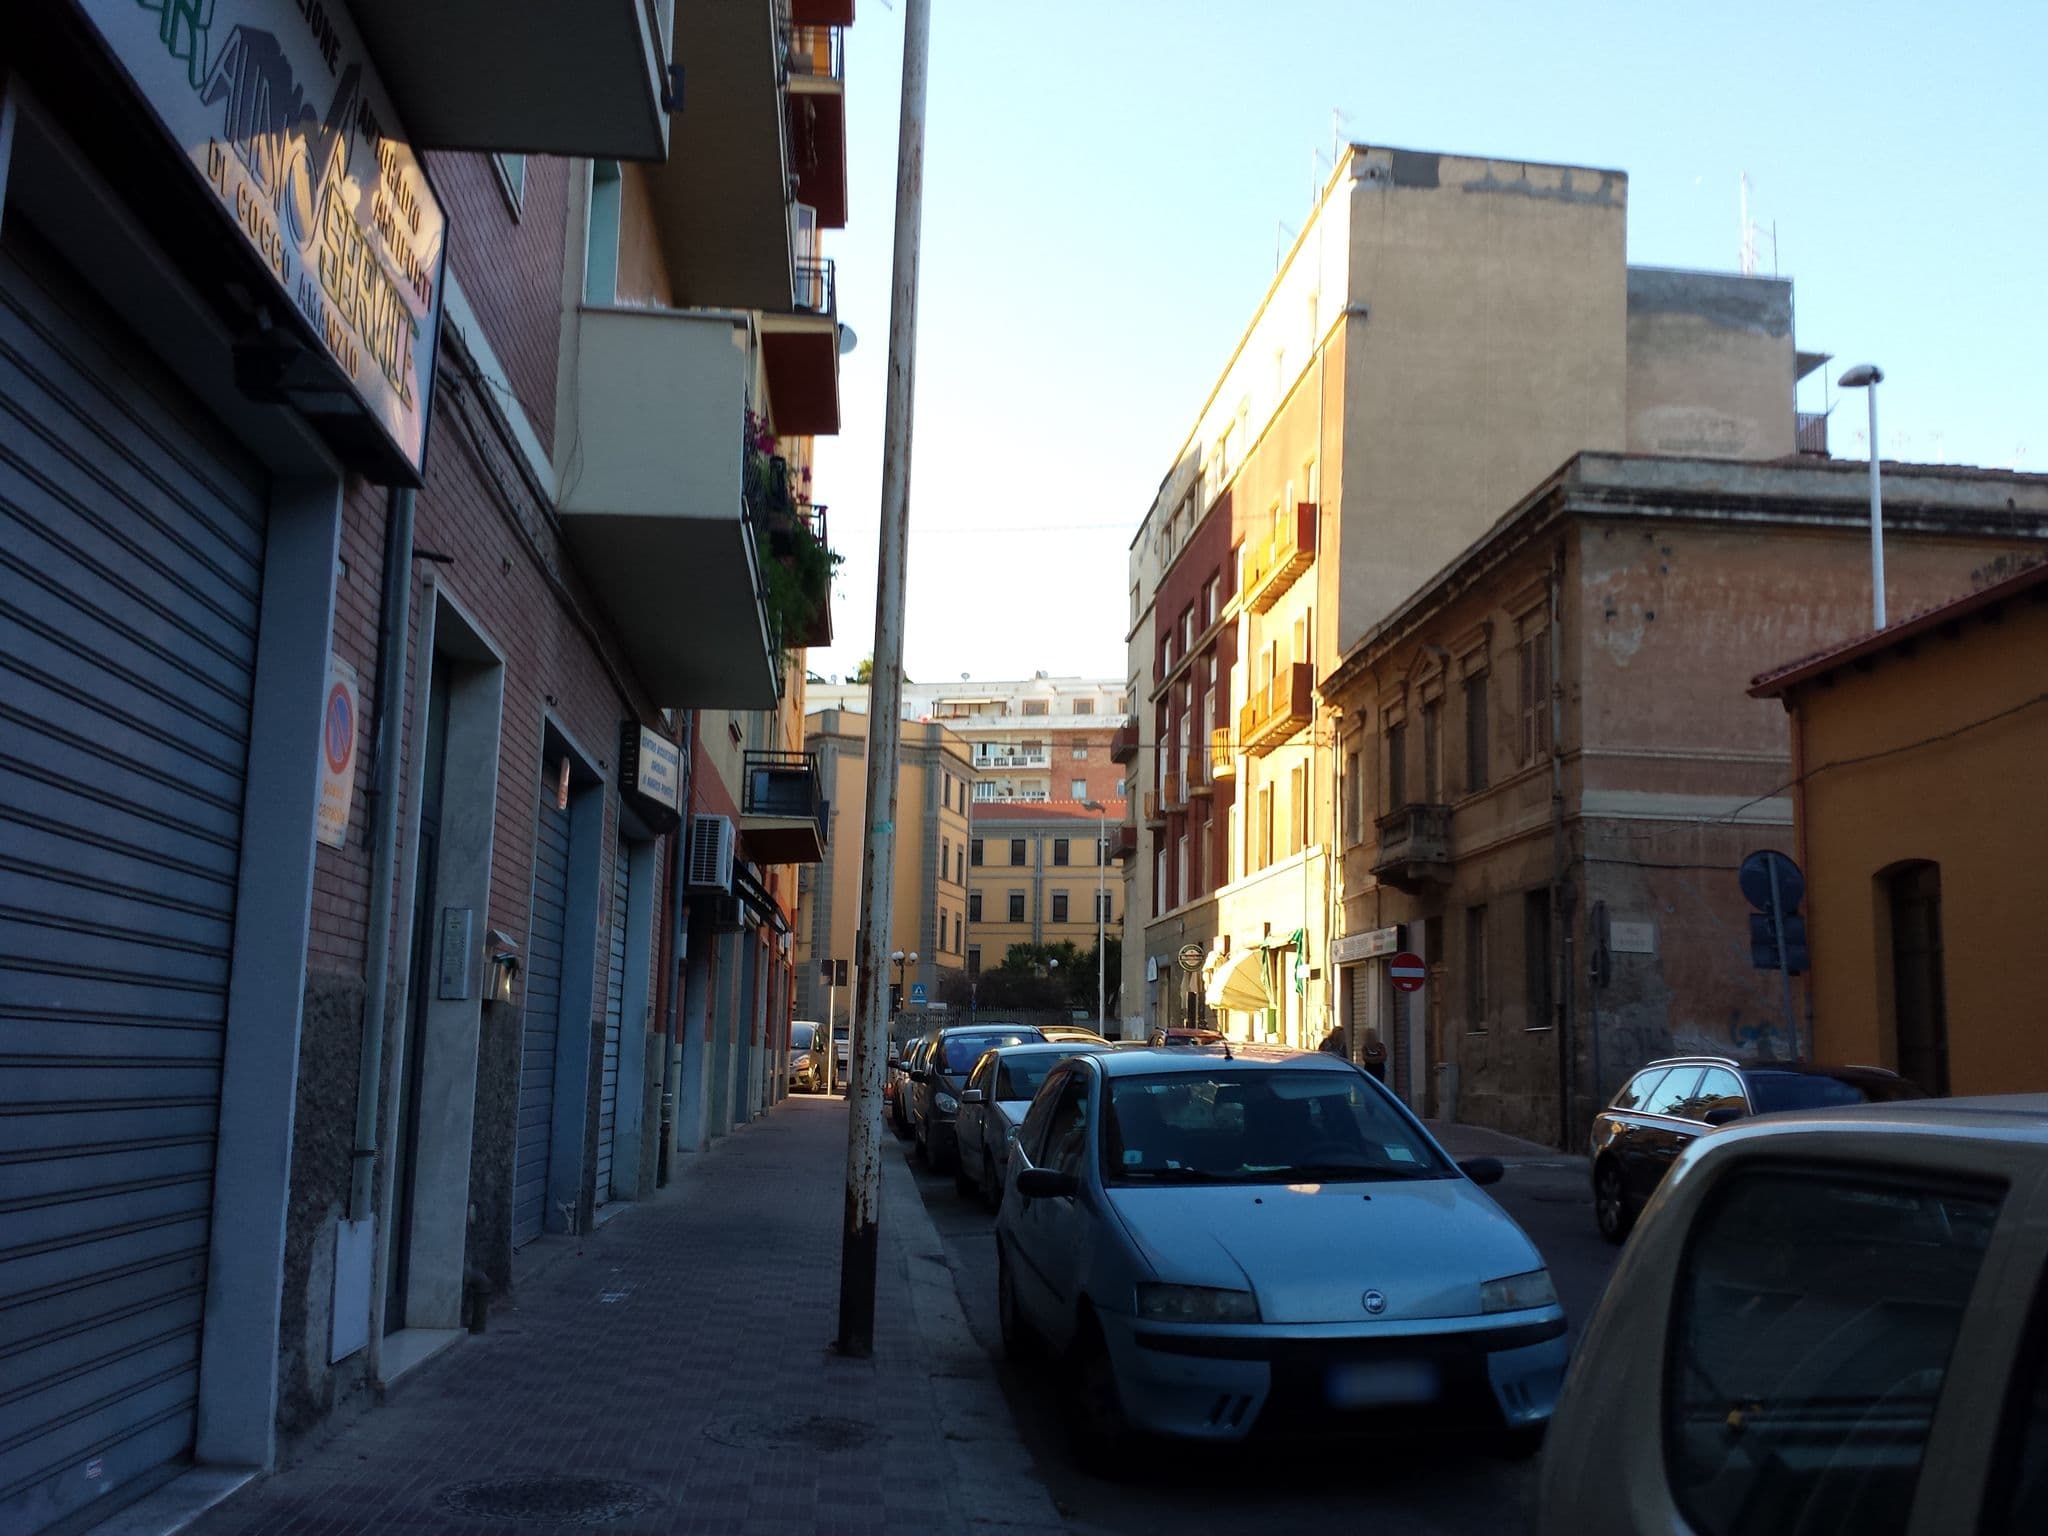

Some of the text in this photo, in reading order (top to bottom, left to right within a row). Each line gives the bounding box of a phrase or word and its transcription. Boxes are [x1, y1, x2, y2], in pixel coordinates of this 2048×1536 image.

[207, 136, 359, 379] DI COCCO AMANZIO
[318, 178, 420, 412] SERVICE
